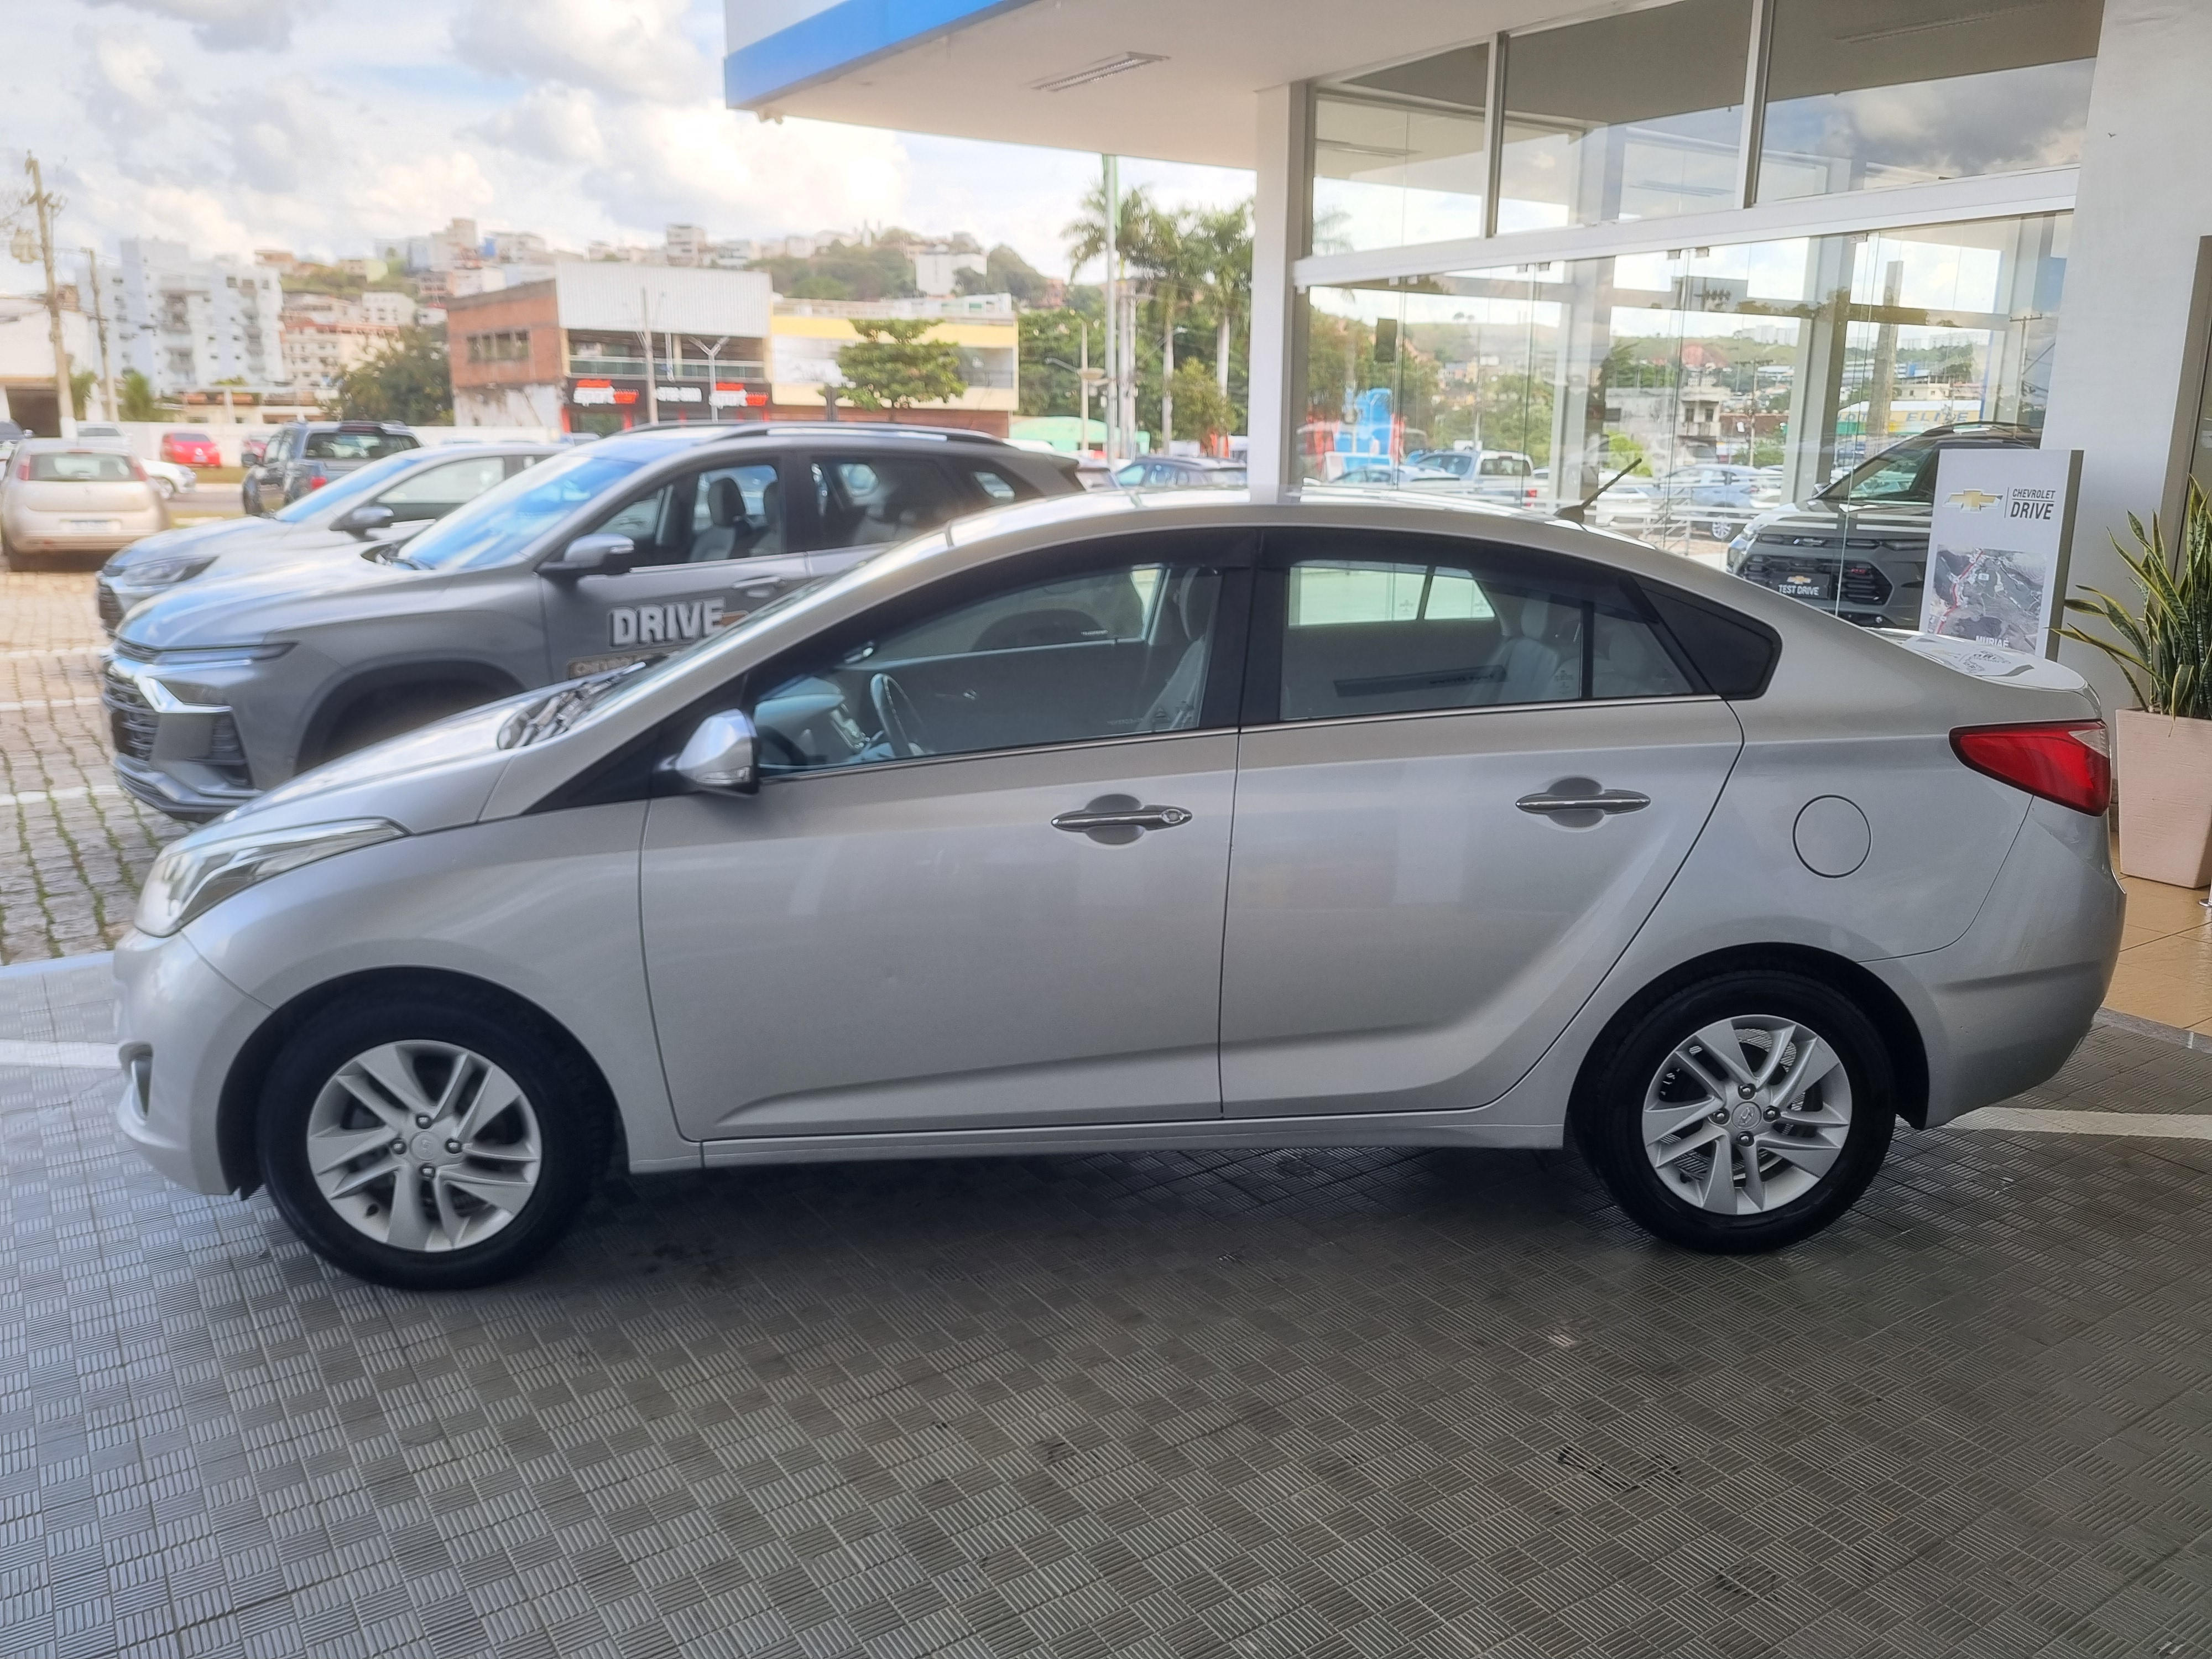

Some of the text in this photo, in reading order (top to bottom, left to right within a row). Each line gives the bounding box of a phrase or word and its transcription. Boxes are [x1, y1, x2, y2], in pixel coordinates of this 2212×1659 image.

[2012, 488, 2056, 499] CHEVROLET
[2010, 501, 2054, 520] DRIVE
[1778, 584, 1819, 596] TEST DRIVE
[612, 599, 724, 645] DRIVE
